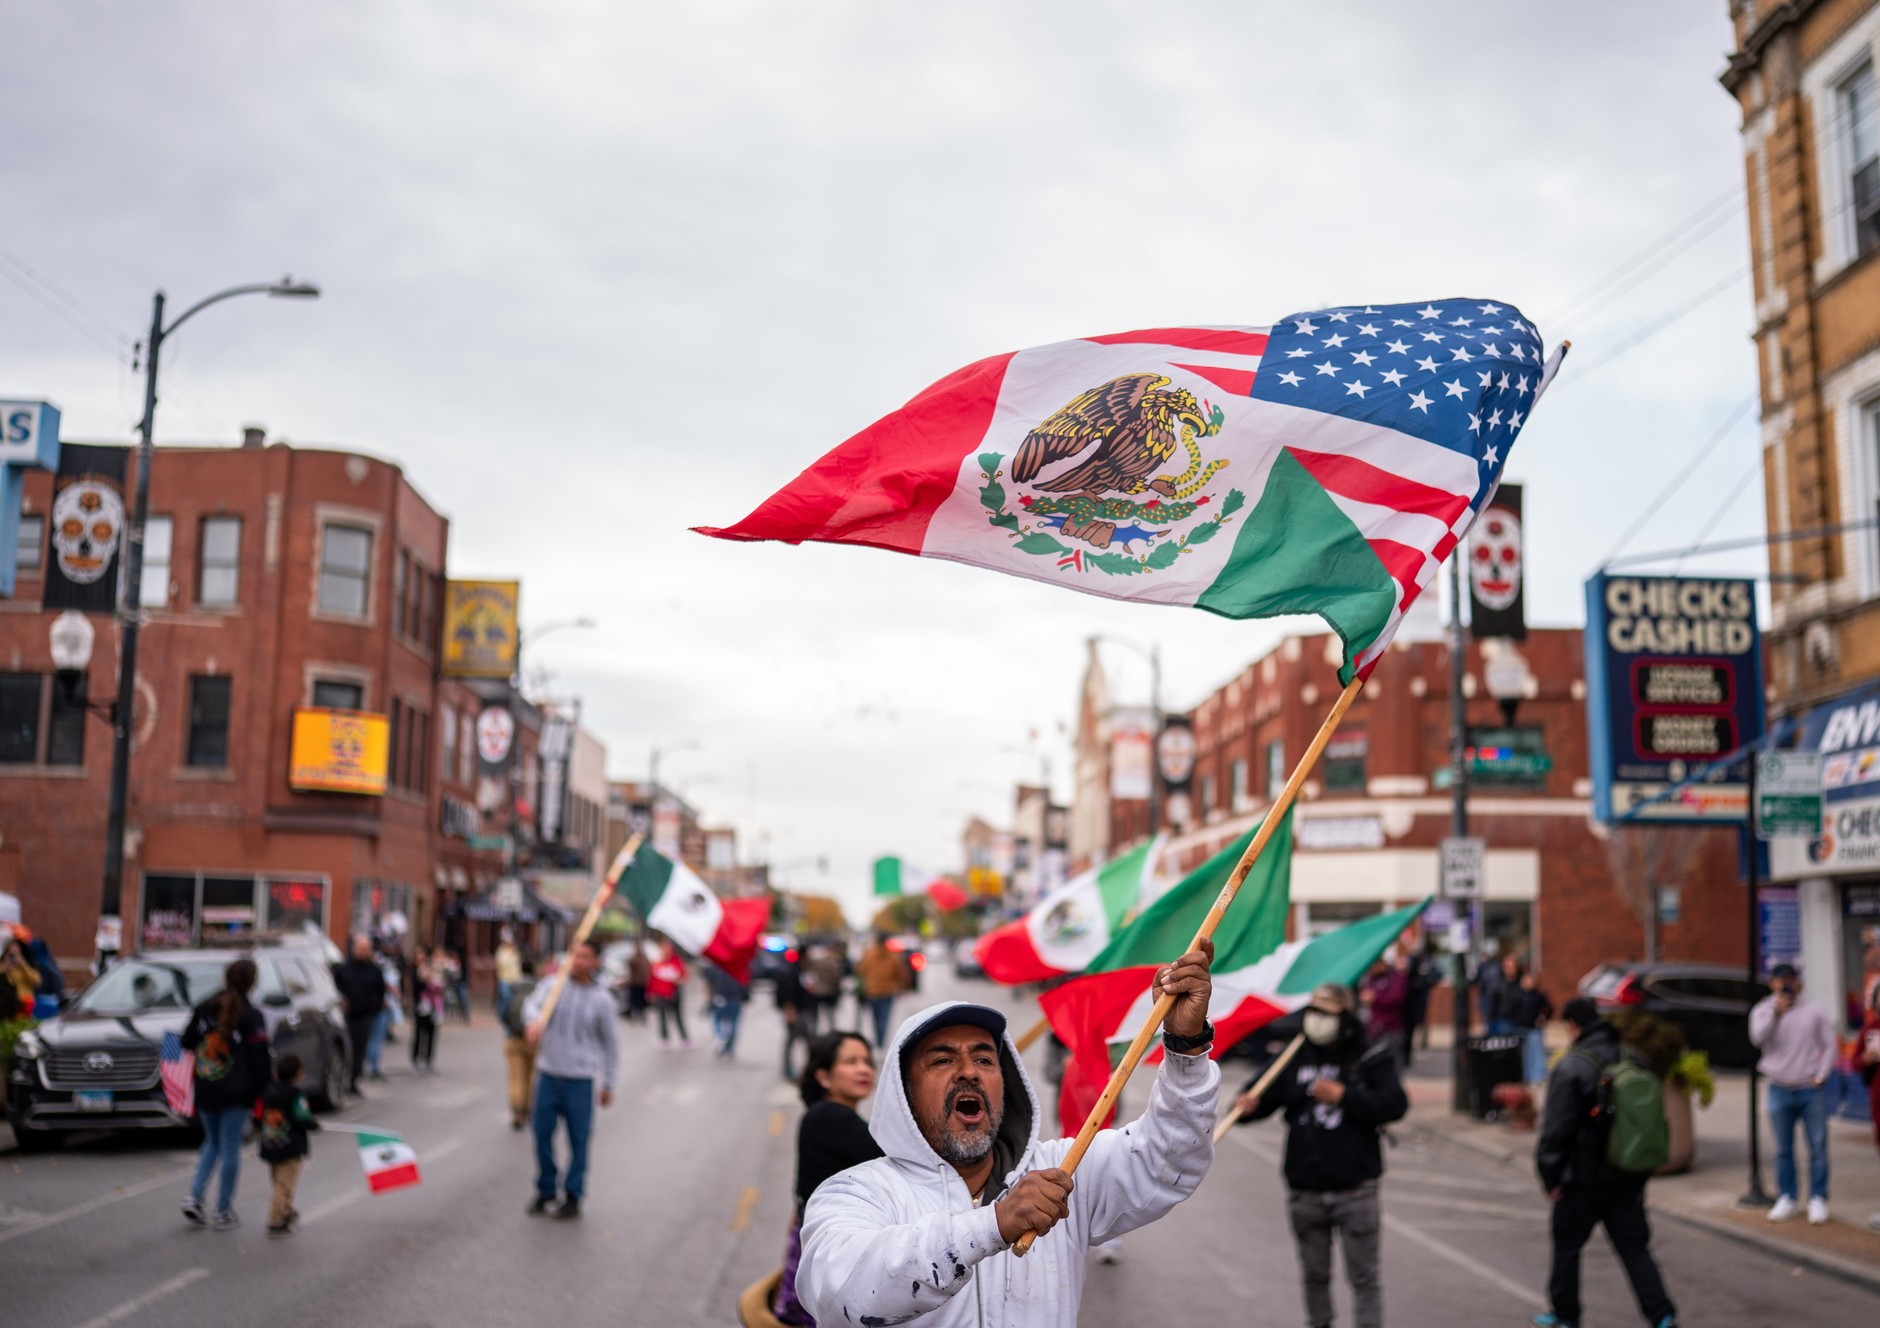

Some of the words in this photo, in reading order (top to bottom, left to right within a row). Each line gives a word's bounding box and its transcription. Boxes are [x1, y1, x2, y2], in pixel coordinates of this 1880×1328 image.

[0, 411, 32, 443] S
[1605, 578, 1751, 619] CHECKS
[1607, 616, 1753, 655] CASHED
[1652, 715, 1717, 734] MONEY
[1818, 699, 1880, 752] ENV
[1651, 733, 1720, 754] ORDERS
